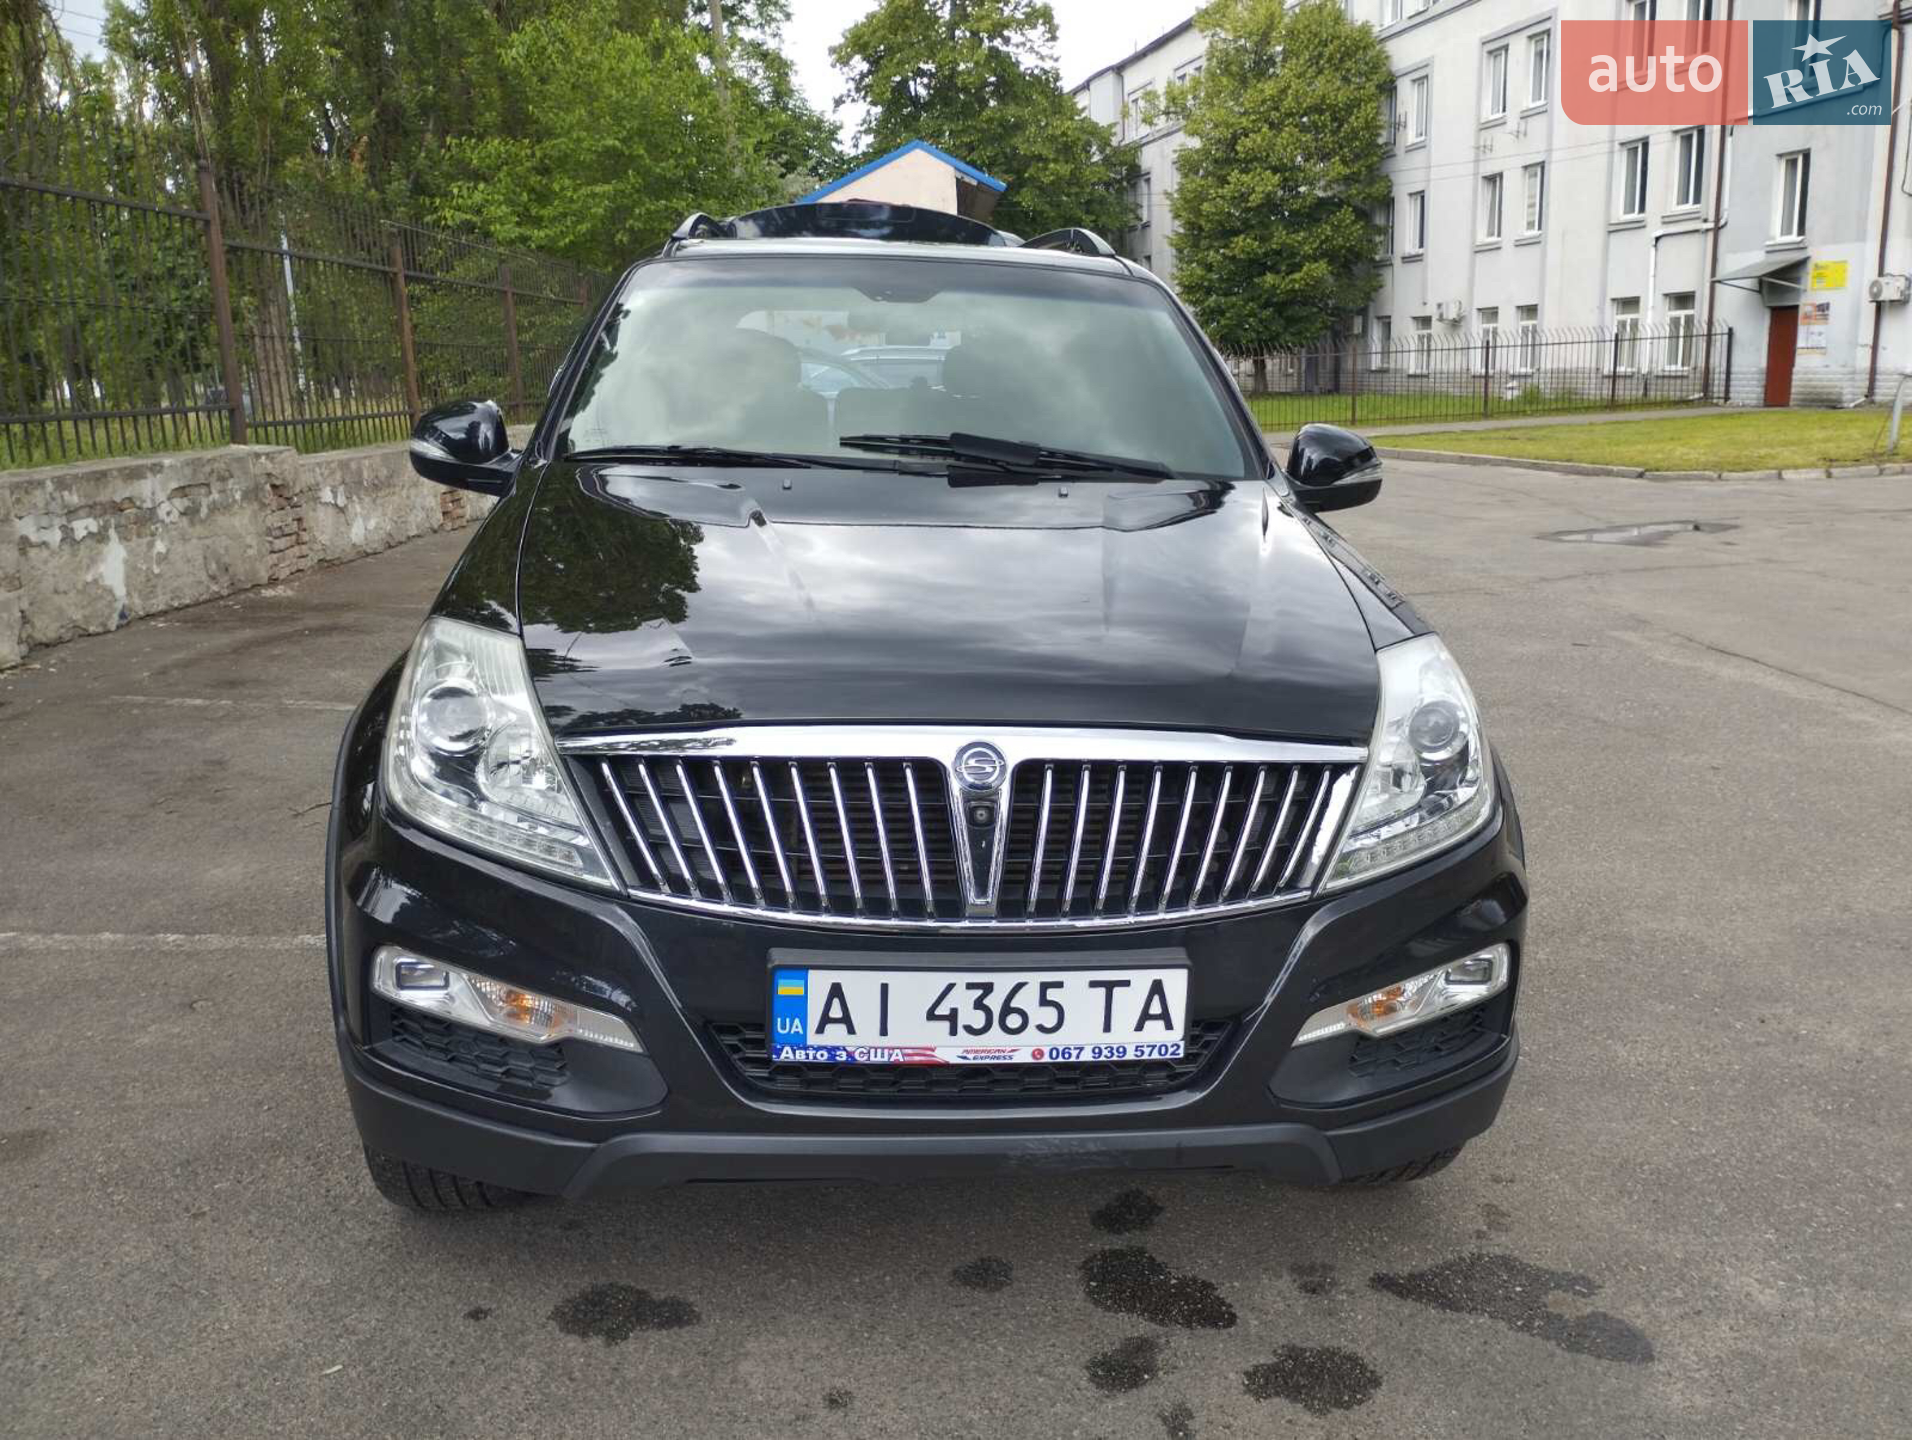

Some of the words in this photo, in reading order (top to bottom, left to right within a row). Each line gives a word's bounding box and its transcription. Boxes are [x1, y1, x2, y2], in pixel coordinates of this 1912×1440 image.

[815, 982, 889, 1036] AI
[926, 981, 1065, 1036] 4365
[1089, 979, 1174, 1033] TA
[777, 1017, 803, 1034] UA
[854, 1048, 904, 1062] США
[1049, 1047, 1083, 1060] 067
[1091, 1045, 1127, 1059] 939
[1134, 1043, 1181, 1058] 5702
